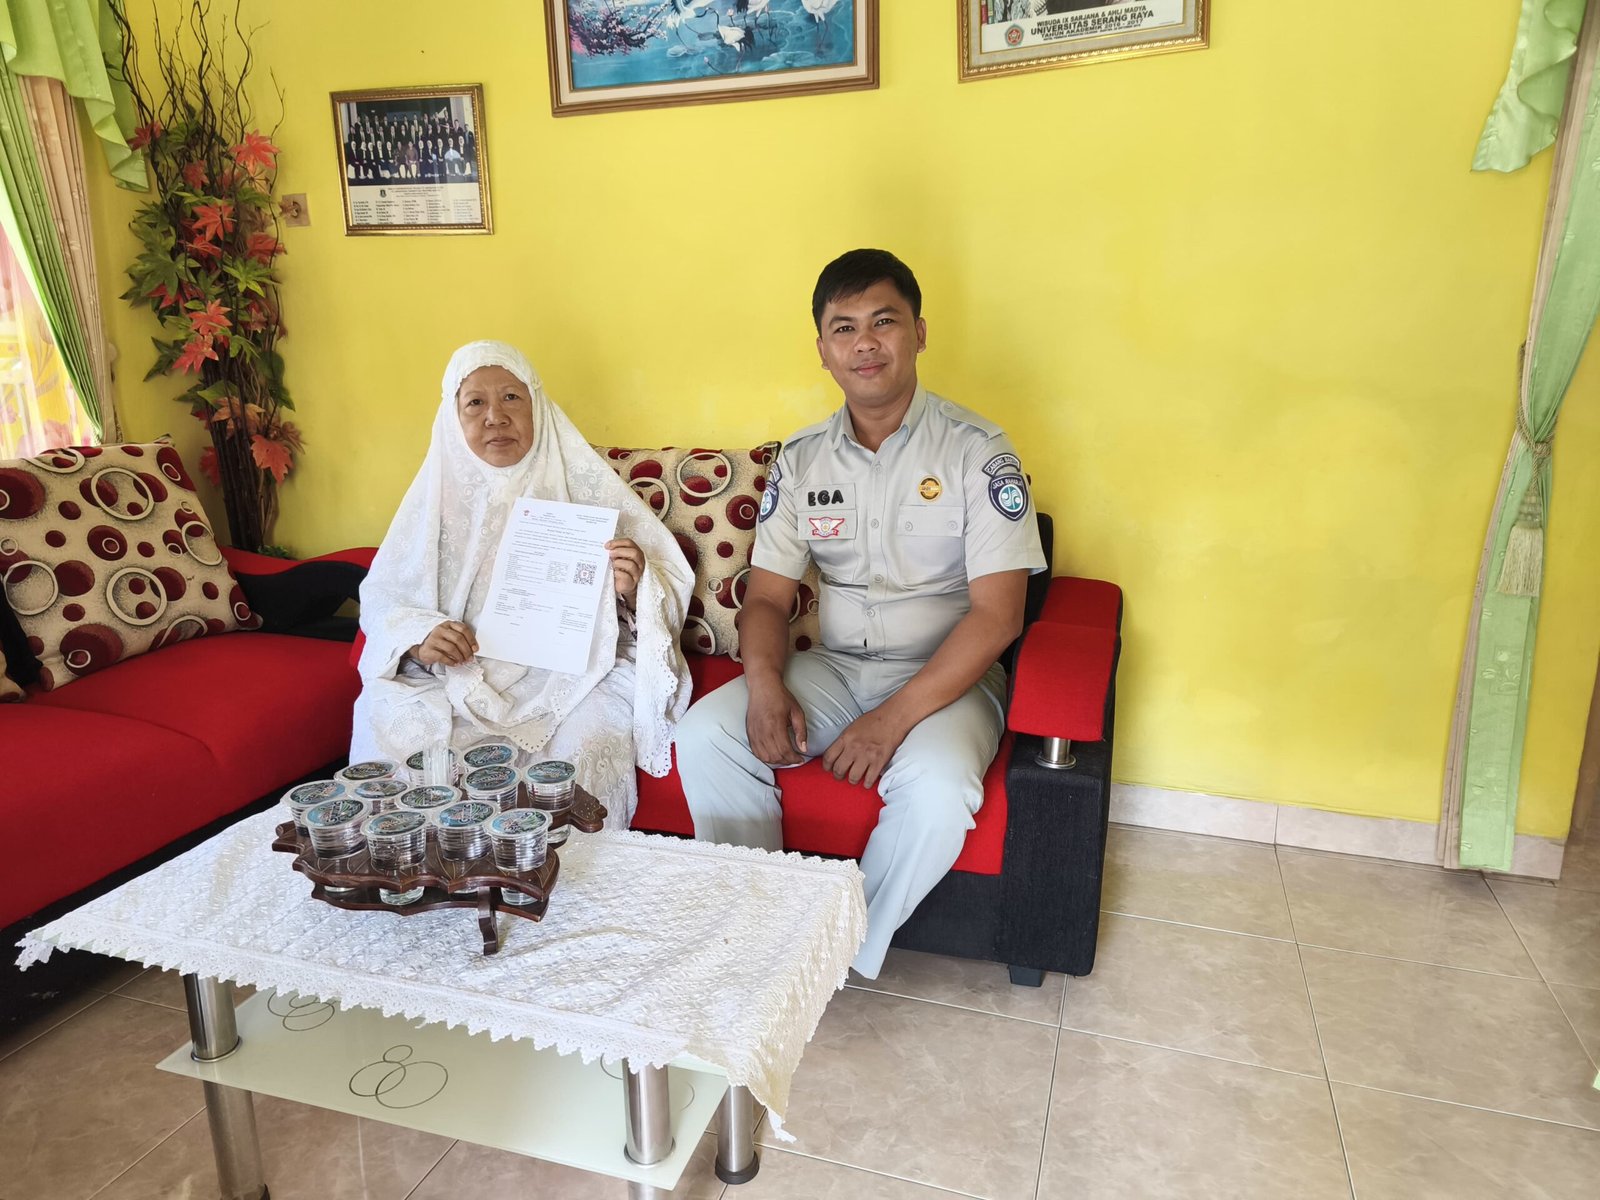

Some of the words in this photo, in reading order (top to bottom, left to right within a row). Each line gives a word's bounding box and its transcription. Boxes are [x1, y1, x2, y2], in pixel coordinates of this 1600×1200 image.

[1031, 19, 1089, 35] UNIVERSITAS
[1091, 14, 1128, 26] SERANG
[1131, 10, 1154, 20] RAYA
[1037, 18, 1061, 27] WISUDA
[1071, 12, 1099, 21] SARJANA
[1125, 5, 1147, 13] MADYA
[992, 480, 1005, 490] JASA
[807, 489, 844, 507] EGA
